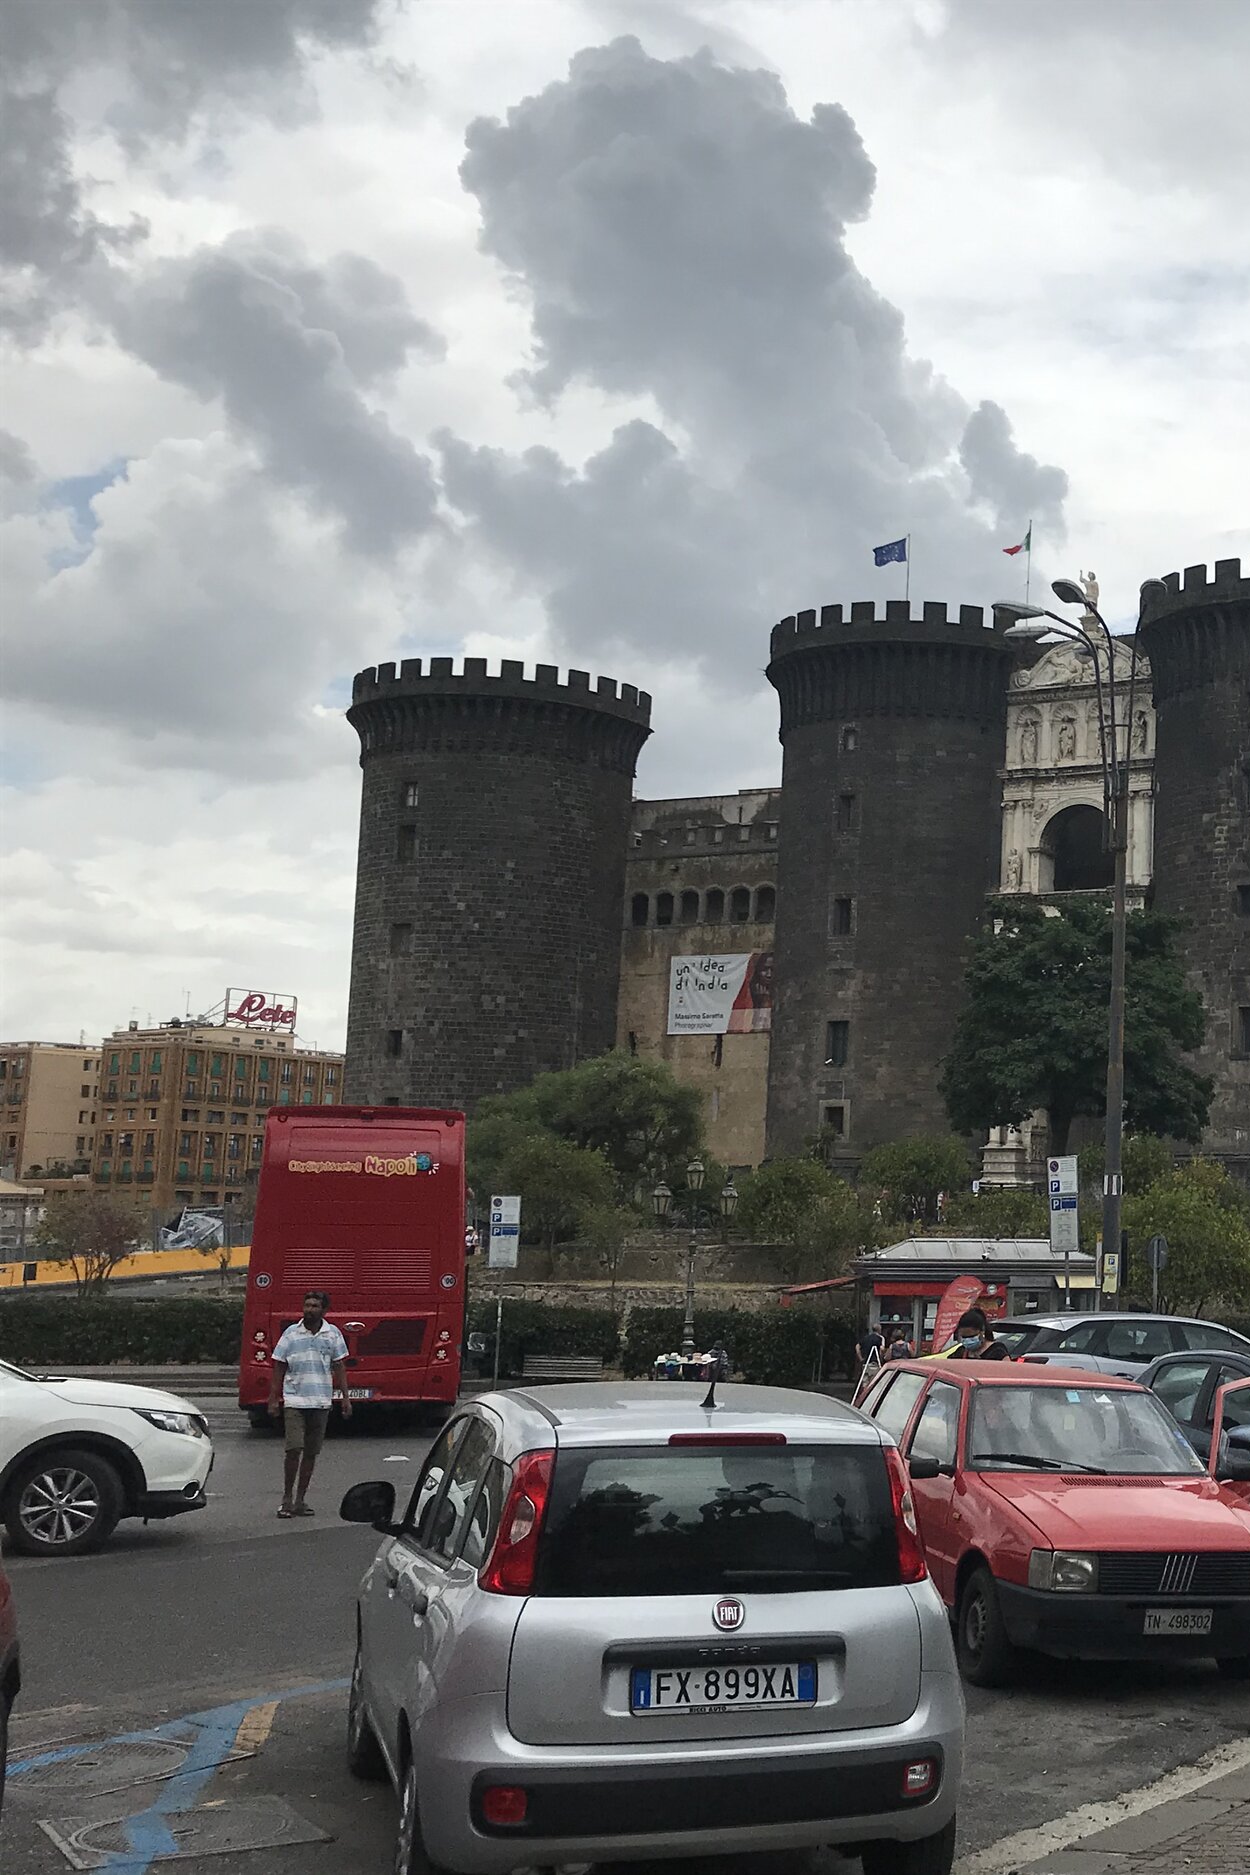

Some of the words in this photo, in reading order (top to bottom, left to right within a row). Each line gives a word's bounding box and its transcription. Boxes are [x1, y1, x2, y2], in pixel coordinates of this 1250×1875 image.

[676, 977, 688, 990] di
[227, 994, 296, 1024] Lete
[365, 1155, 417, 1177] Napoli
[1052, 1181, 1059, 1191] P
[1053, 1199, 1060, 1209] P
[720, 1605, 738, 1621] FIAT
[1168, 1614, 1211, 1629] 498302
[704, 1666, 796, 1701] 899XA
[709, 1705, 727, 1713] AUTO
